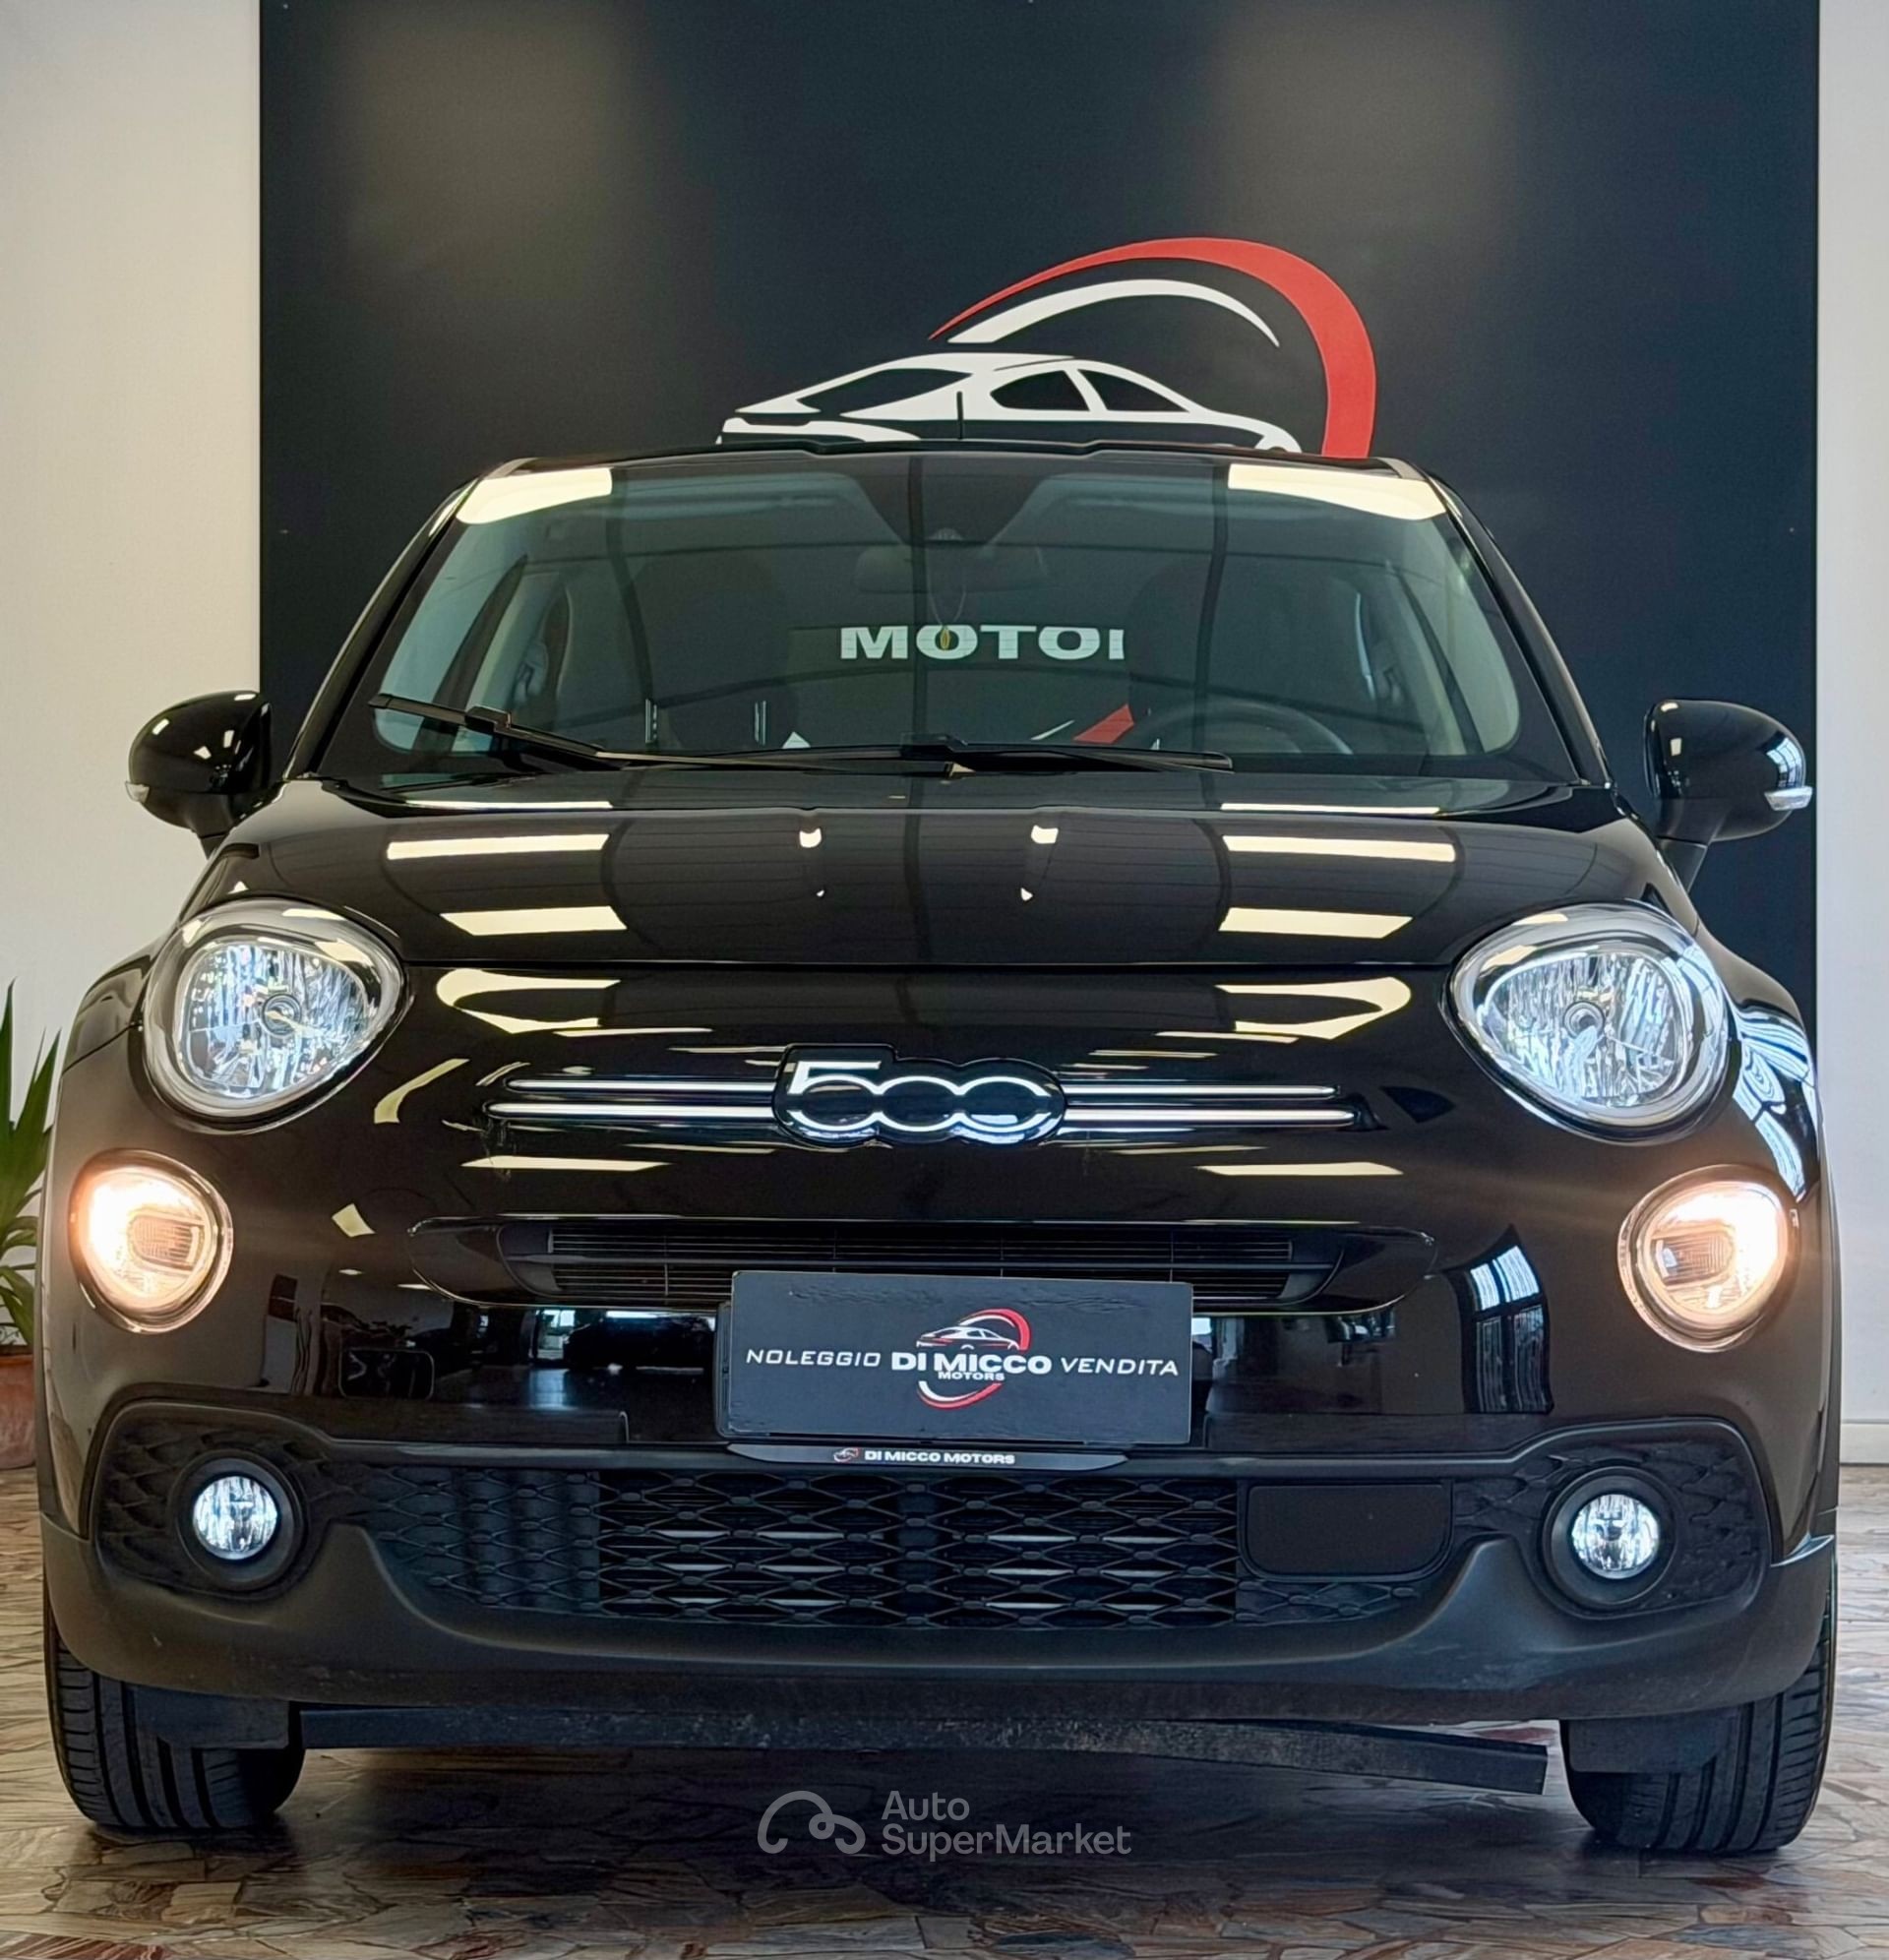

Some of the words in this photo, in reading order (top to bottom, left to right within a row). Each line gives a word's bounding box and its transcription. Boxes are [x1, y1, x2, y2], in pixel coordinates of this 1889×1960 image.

[787, 1060, 1052, 1133] 500
[746, 1349, 882, 1367] NOLEGGIO
[891, 1352, 927, 1371] DI
[934, 1353, 1053, 1375] MICCO
[1061, 1357, 1179, 1376] VENDITA
[938, 1371, 1005, 1381] MOTORS
[864, 1450, 882, 1461] DI
[884, 1450, 942, 1462] MICCO
[944, 1452, 1016, 1465] MOTORS
